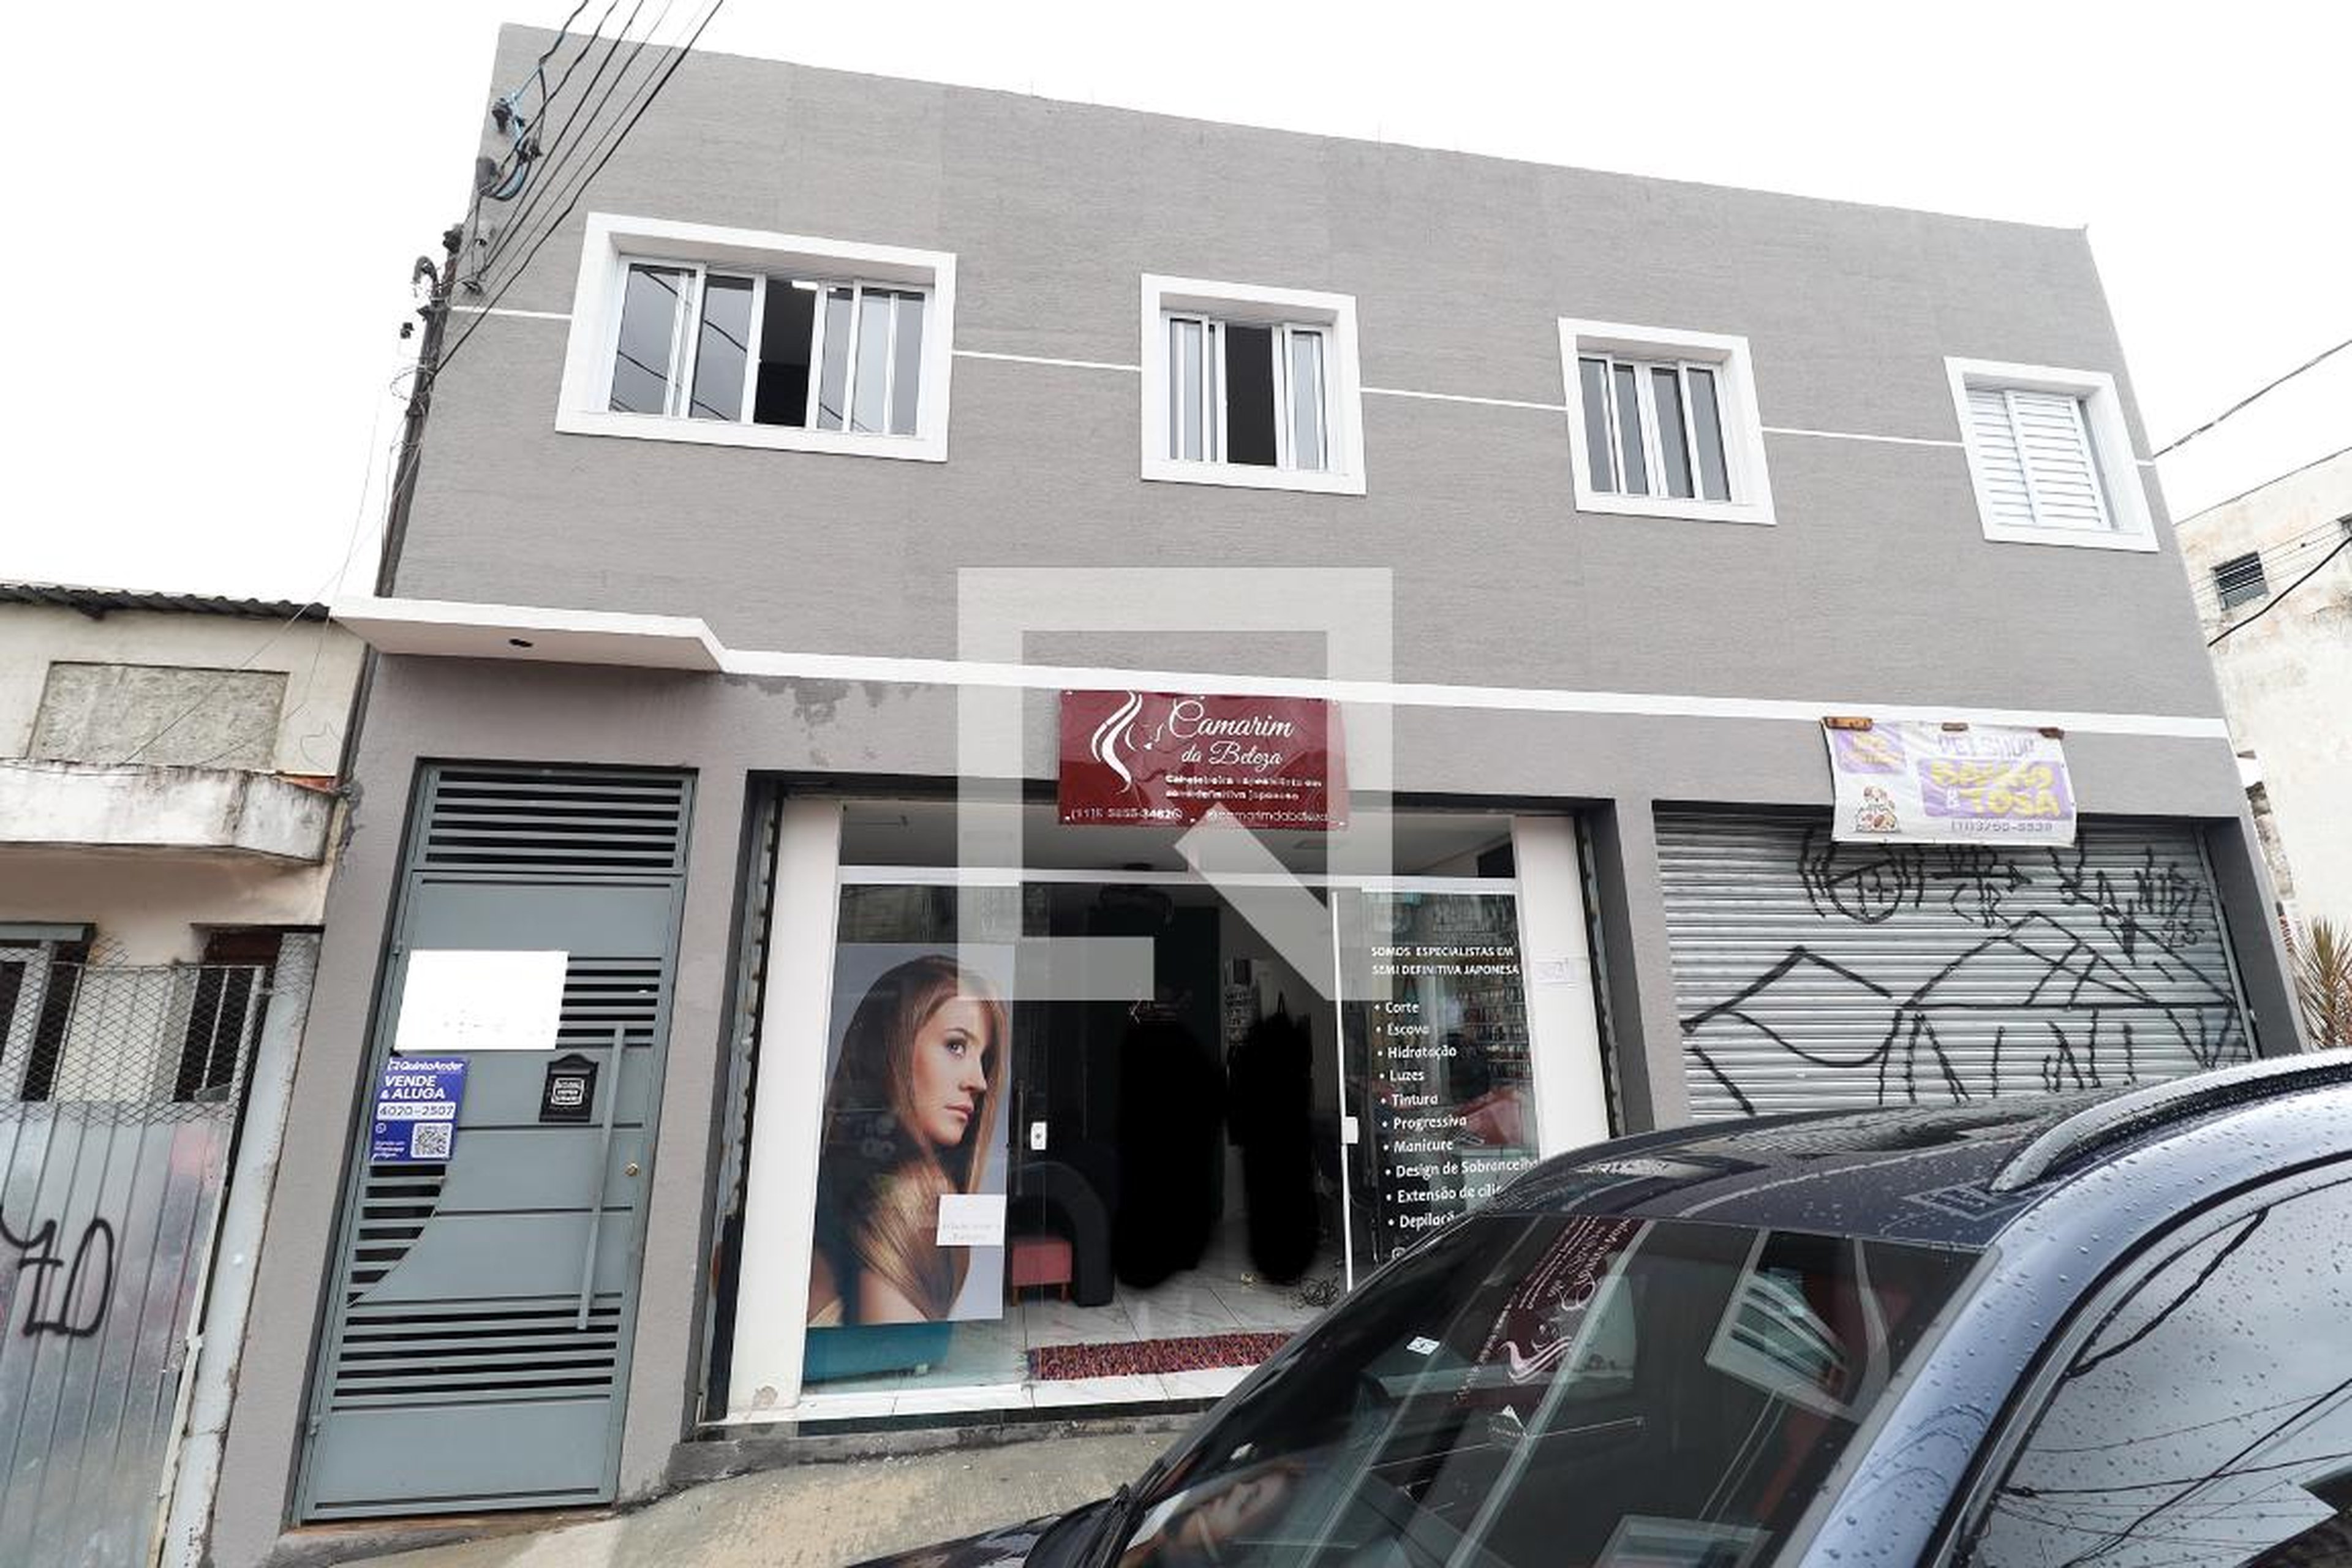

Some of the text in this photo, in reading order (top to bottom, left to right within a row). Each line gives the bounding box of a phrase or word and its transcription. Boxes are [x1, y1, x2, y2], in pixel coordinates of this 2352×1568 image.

[1169, 698, 1294, 739] Camarim
[1182, 741, 1283, 773] da Beleza
[1959, 788, 2060, 816] TOSA
[1371, 947, 1514, 957] SOMOS ESPECIALISTAS EM
[1372, 965, 1520, 975] SEMI DEFINITIVA JAPONESA
[1385, 1002, 1419, 1013] Corte
[1387, 1025, 1430, 1036] Escova
[1387, 1046, 1457, 1061] Hidratação
[385, 1075, 437, 1087] VENDE
[1390, 1069, 1425, 1082] Luzes
[391, 1088, 445, 1099] ALUGA
[1391, 1093, 1438, 1106] Tintura
[1393, 1114, 1467, 1132] Progressiva
[1393, 1139, 1453, 1152] Manicure
[1396, 1164, 1440, 1180] Design
[1442, 1161, 1457, 1175] de
[1397, 1186, 1457, 1203] Extensão
[1459, 1185, 1475, 1198] de
